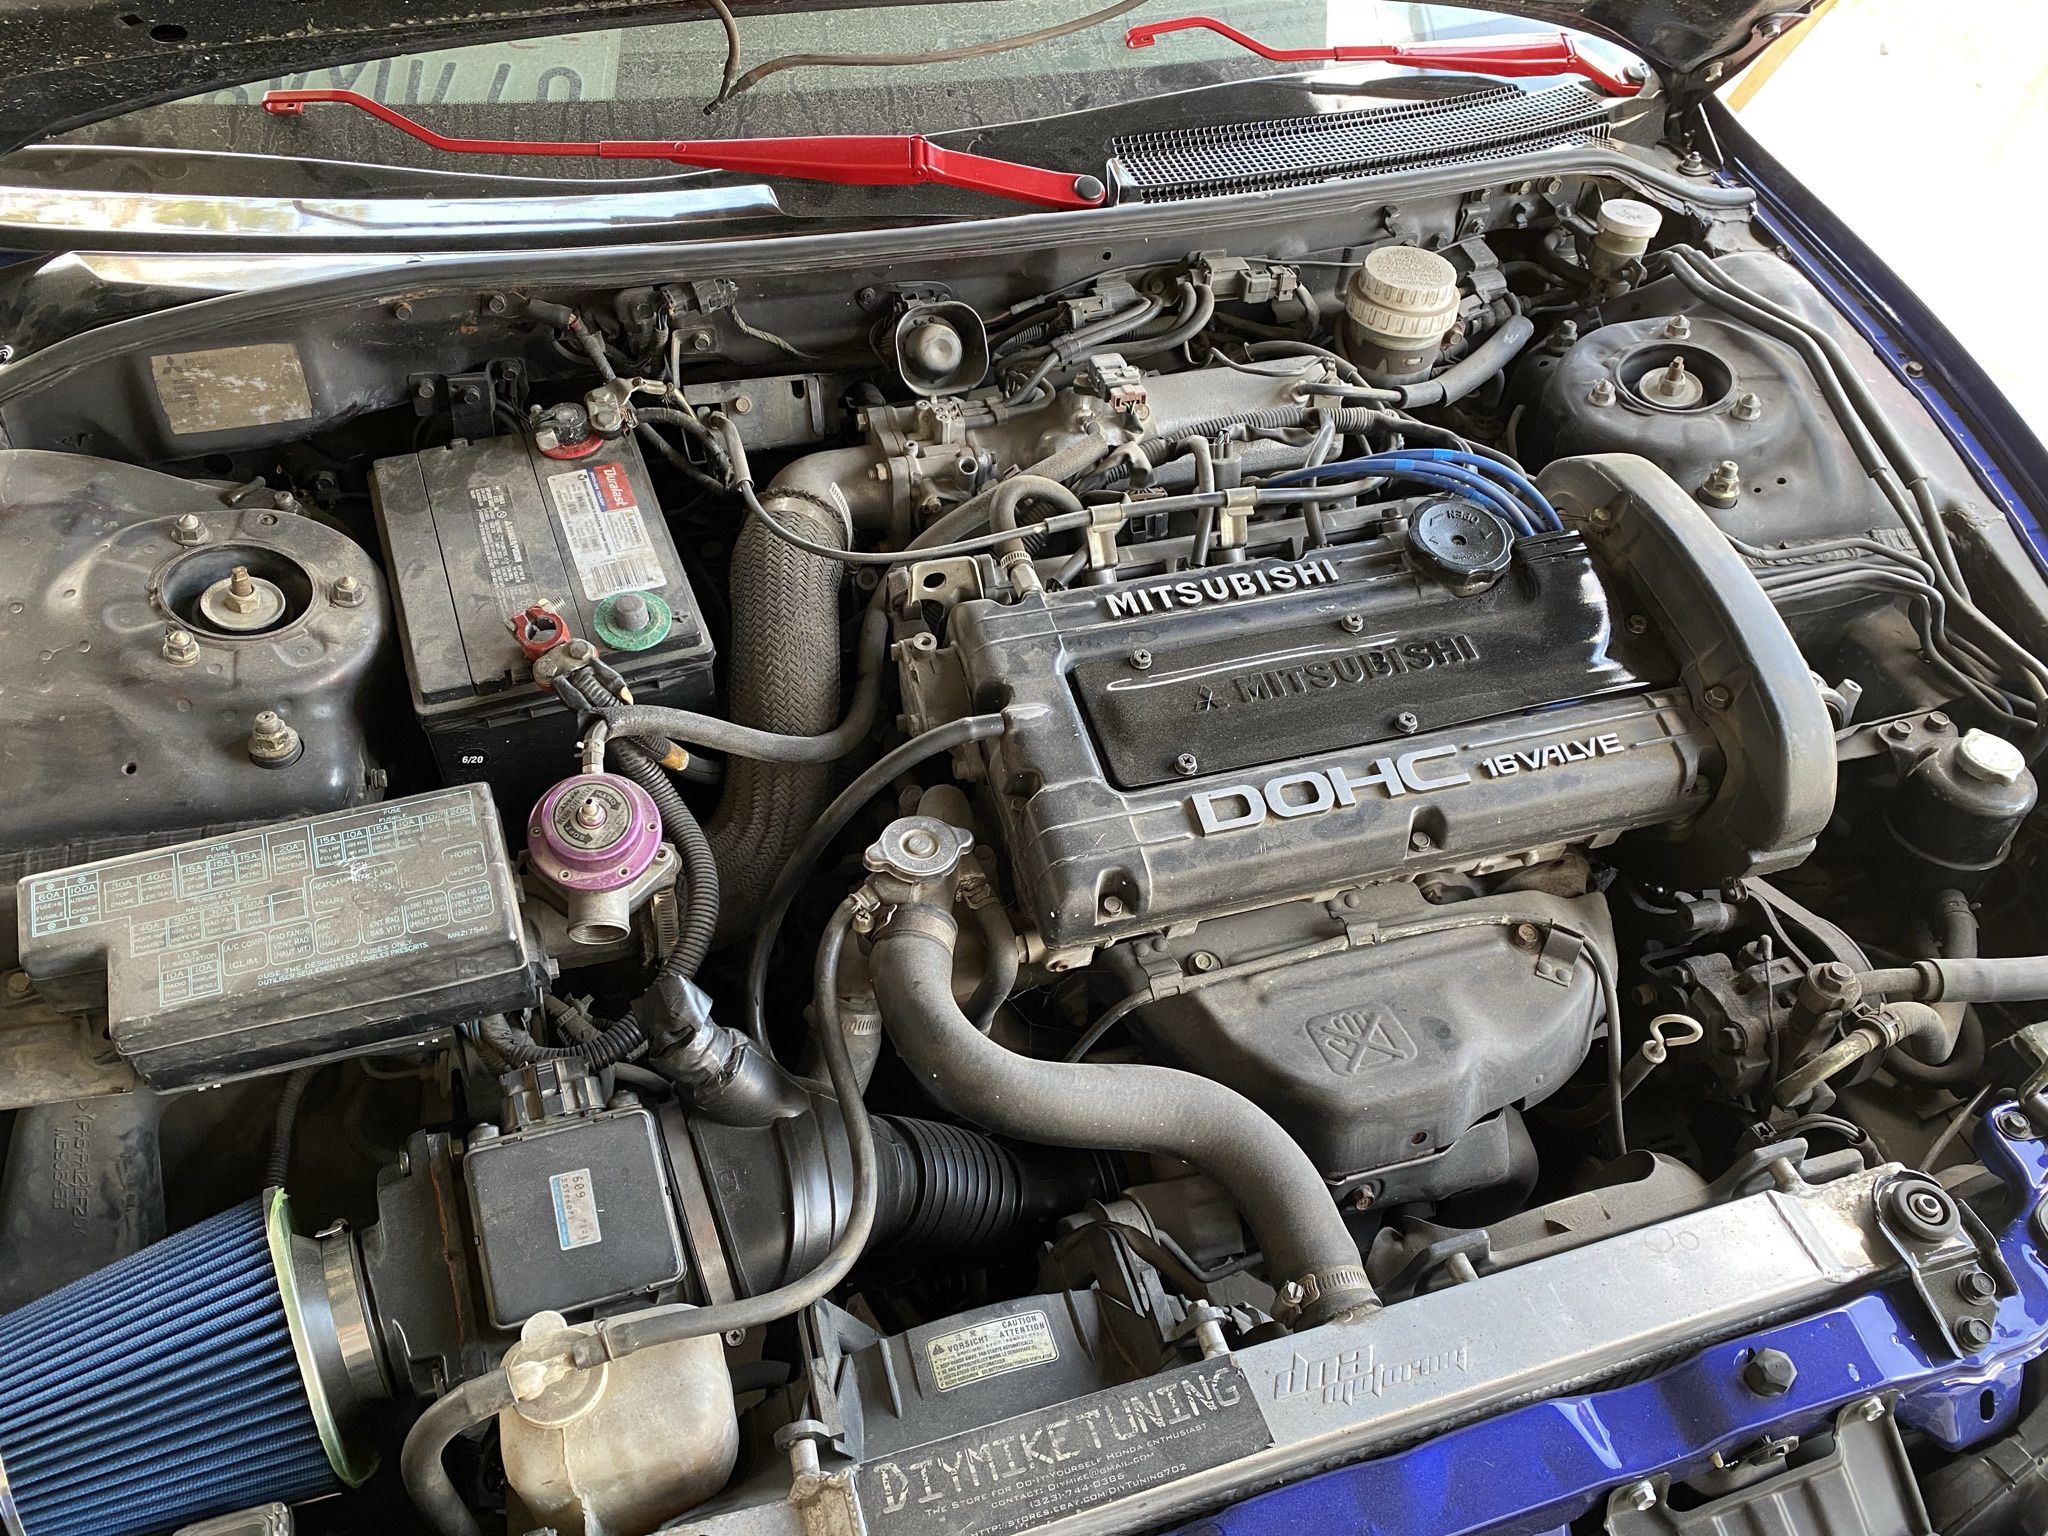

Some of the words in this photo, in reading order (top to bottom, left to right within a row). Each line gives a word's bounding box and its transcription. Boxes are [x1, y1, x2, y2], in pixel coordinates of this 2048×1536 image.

[604, 466, 629, 507] Duralast
[1446, 510, 1480, 524] OPEN
[1105, 558, 1339, 620] MITSUBISHI
[1233, 634, 1480, 703] MITSUBISHI
[462, 755, 484, 764] 6/20
[1191, 744, 1471, 837] DOHC
[346, 830, 363, 839] 10A
[373, 825, 389, 834] 15A
[320, 836, 336, 844] 15A
[210, 844, 230, 852] FUSE
[280, 844, 300, 852] 20A
[450, 848, 477, 858] HORN
[206, 850, 236, 860] FUSIBLE
[240, 853, 257, 862] 15A
[186, 866, 202, 874] 15A
[213, 859, 230, 868] 15A
[70, 884, 96, 895] 100A
[162, 952, 217, 970] ALIMENTATION
[284, 965, 301, 974] THE
[304, 952, 358, 970] DESIGNATED
[360, 944, 388, 956] FUSES
[166, 970, 184, 980] 10A
[258, 973, 296, 986] OUTILISER
[297, 964, 338, 978] SEULEMENT
[1002, 1316, 1037, 1329] CAUTION
[1000, 1322, 1045, 1338] ATTENTION
[948, 1335, 989, 1353] VORSICHT
[873, 1367, 1241, 1515] DIYMIKETUNING
[952, 1494, 988, 1509] STORE
[992, 1486, 1012, 1498] FOR
[1106, 1444, 1143, 1461] HONDA
[1146, 1422, 1208, 1448] ENTHUSIAST
[992, 1487, 1044, 1509] CONTACT:
